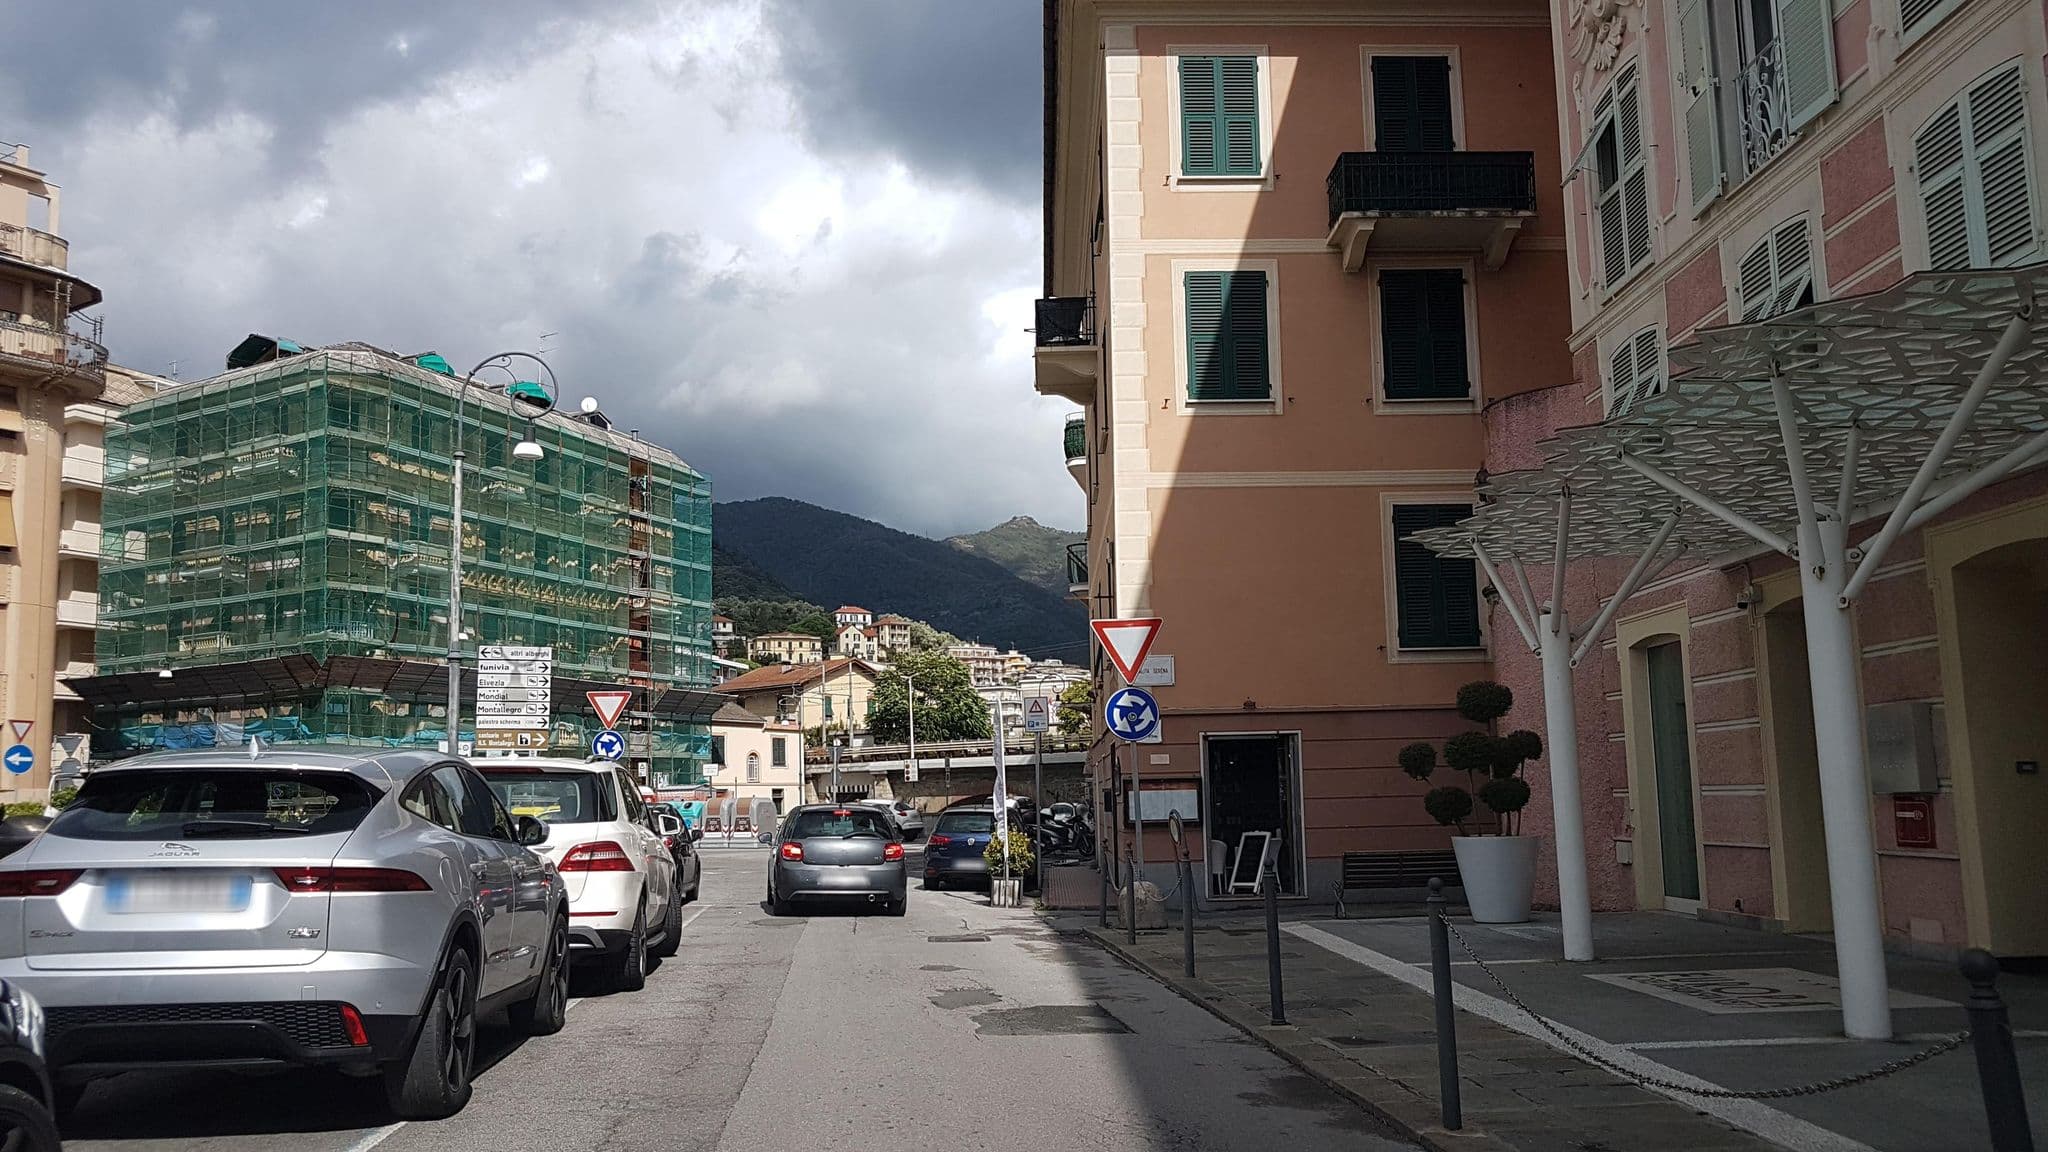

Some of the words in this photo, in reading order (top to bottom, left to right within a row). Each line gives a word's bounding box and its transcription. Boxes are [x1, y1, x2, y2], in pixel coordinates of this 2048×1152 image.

[525, 650, 549, 658] alberghi
[480, 663, 510, 671] funivia
[477, 706, 522, 714] Montallegro
